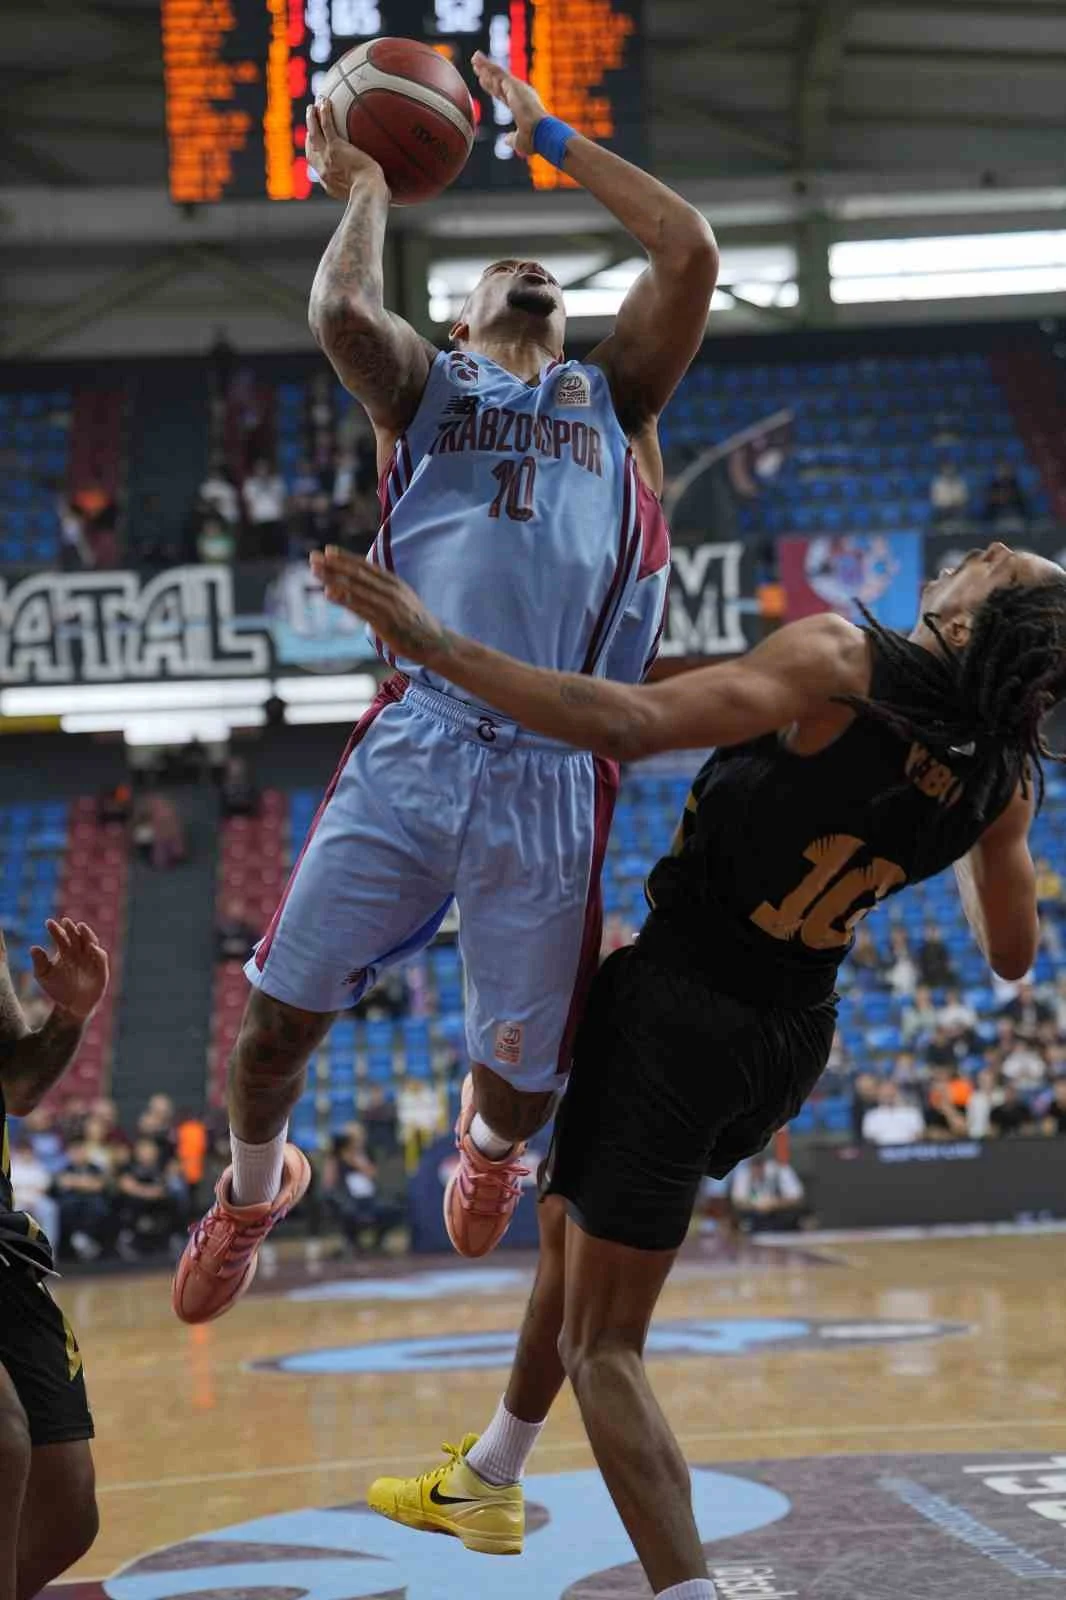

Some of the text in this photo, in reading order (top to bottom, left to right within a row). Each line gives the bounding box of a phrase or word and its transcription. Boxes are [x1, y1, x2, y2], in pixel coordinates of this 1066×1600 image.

[488, 455, 537, 522] 10
[0, 564, 271, 682] ATAL
[749, 832, 908, 950] 10
